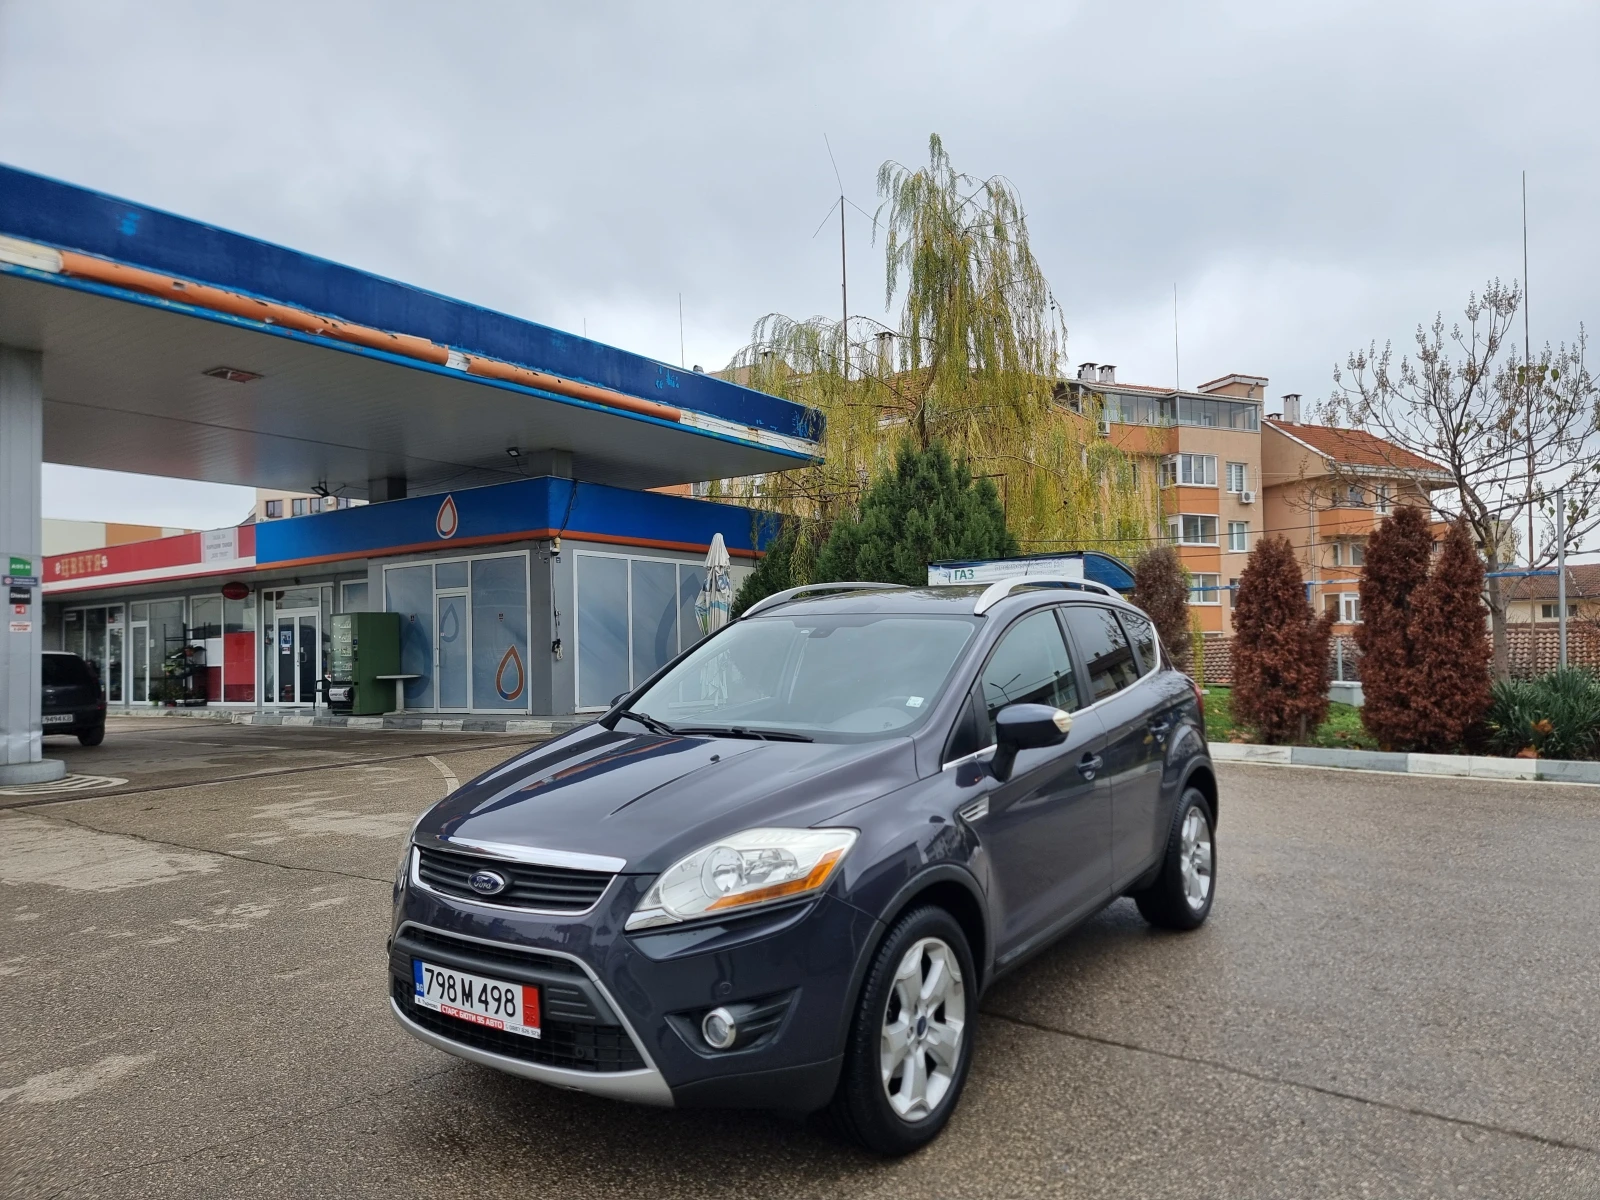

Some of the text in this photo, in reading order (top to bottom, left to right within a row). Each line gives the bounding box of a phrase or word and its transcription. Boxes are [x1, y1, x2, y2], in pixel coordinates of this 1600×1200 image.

[61, 553, 102, 578] ЦВЕТЯ
[954, 568, 975, 580] ГАЗ
[473, 875, 494, 890] Ford
[416, 982, 424, 993] BG
[441, 1005, 503, 1029] СТАРС БЮТИ 95 АВТО
